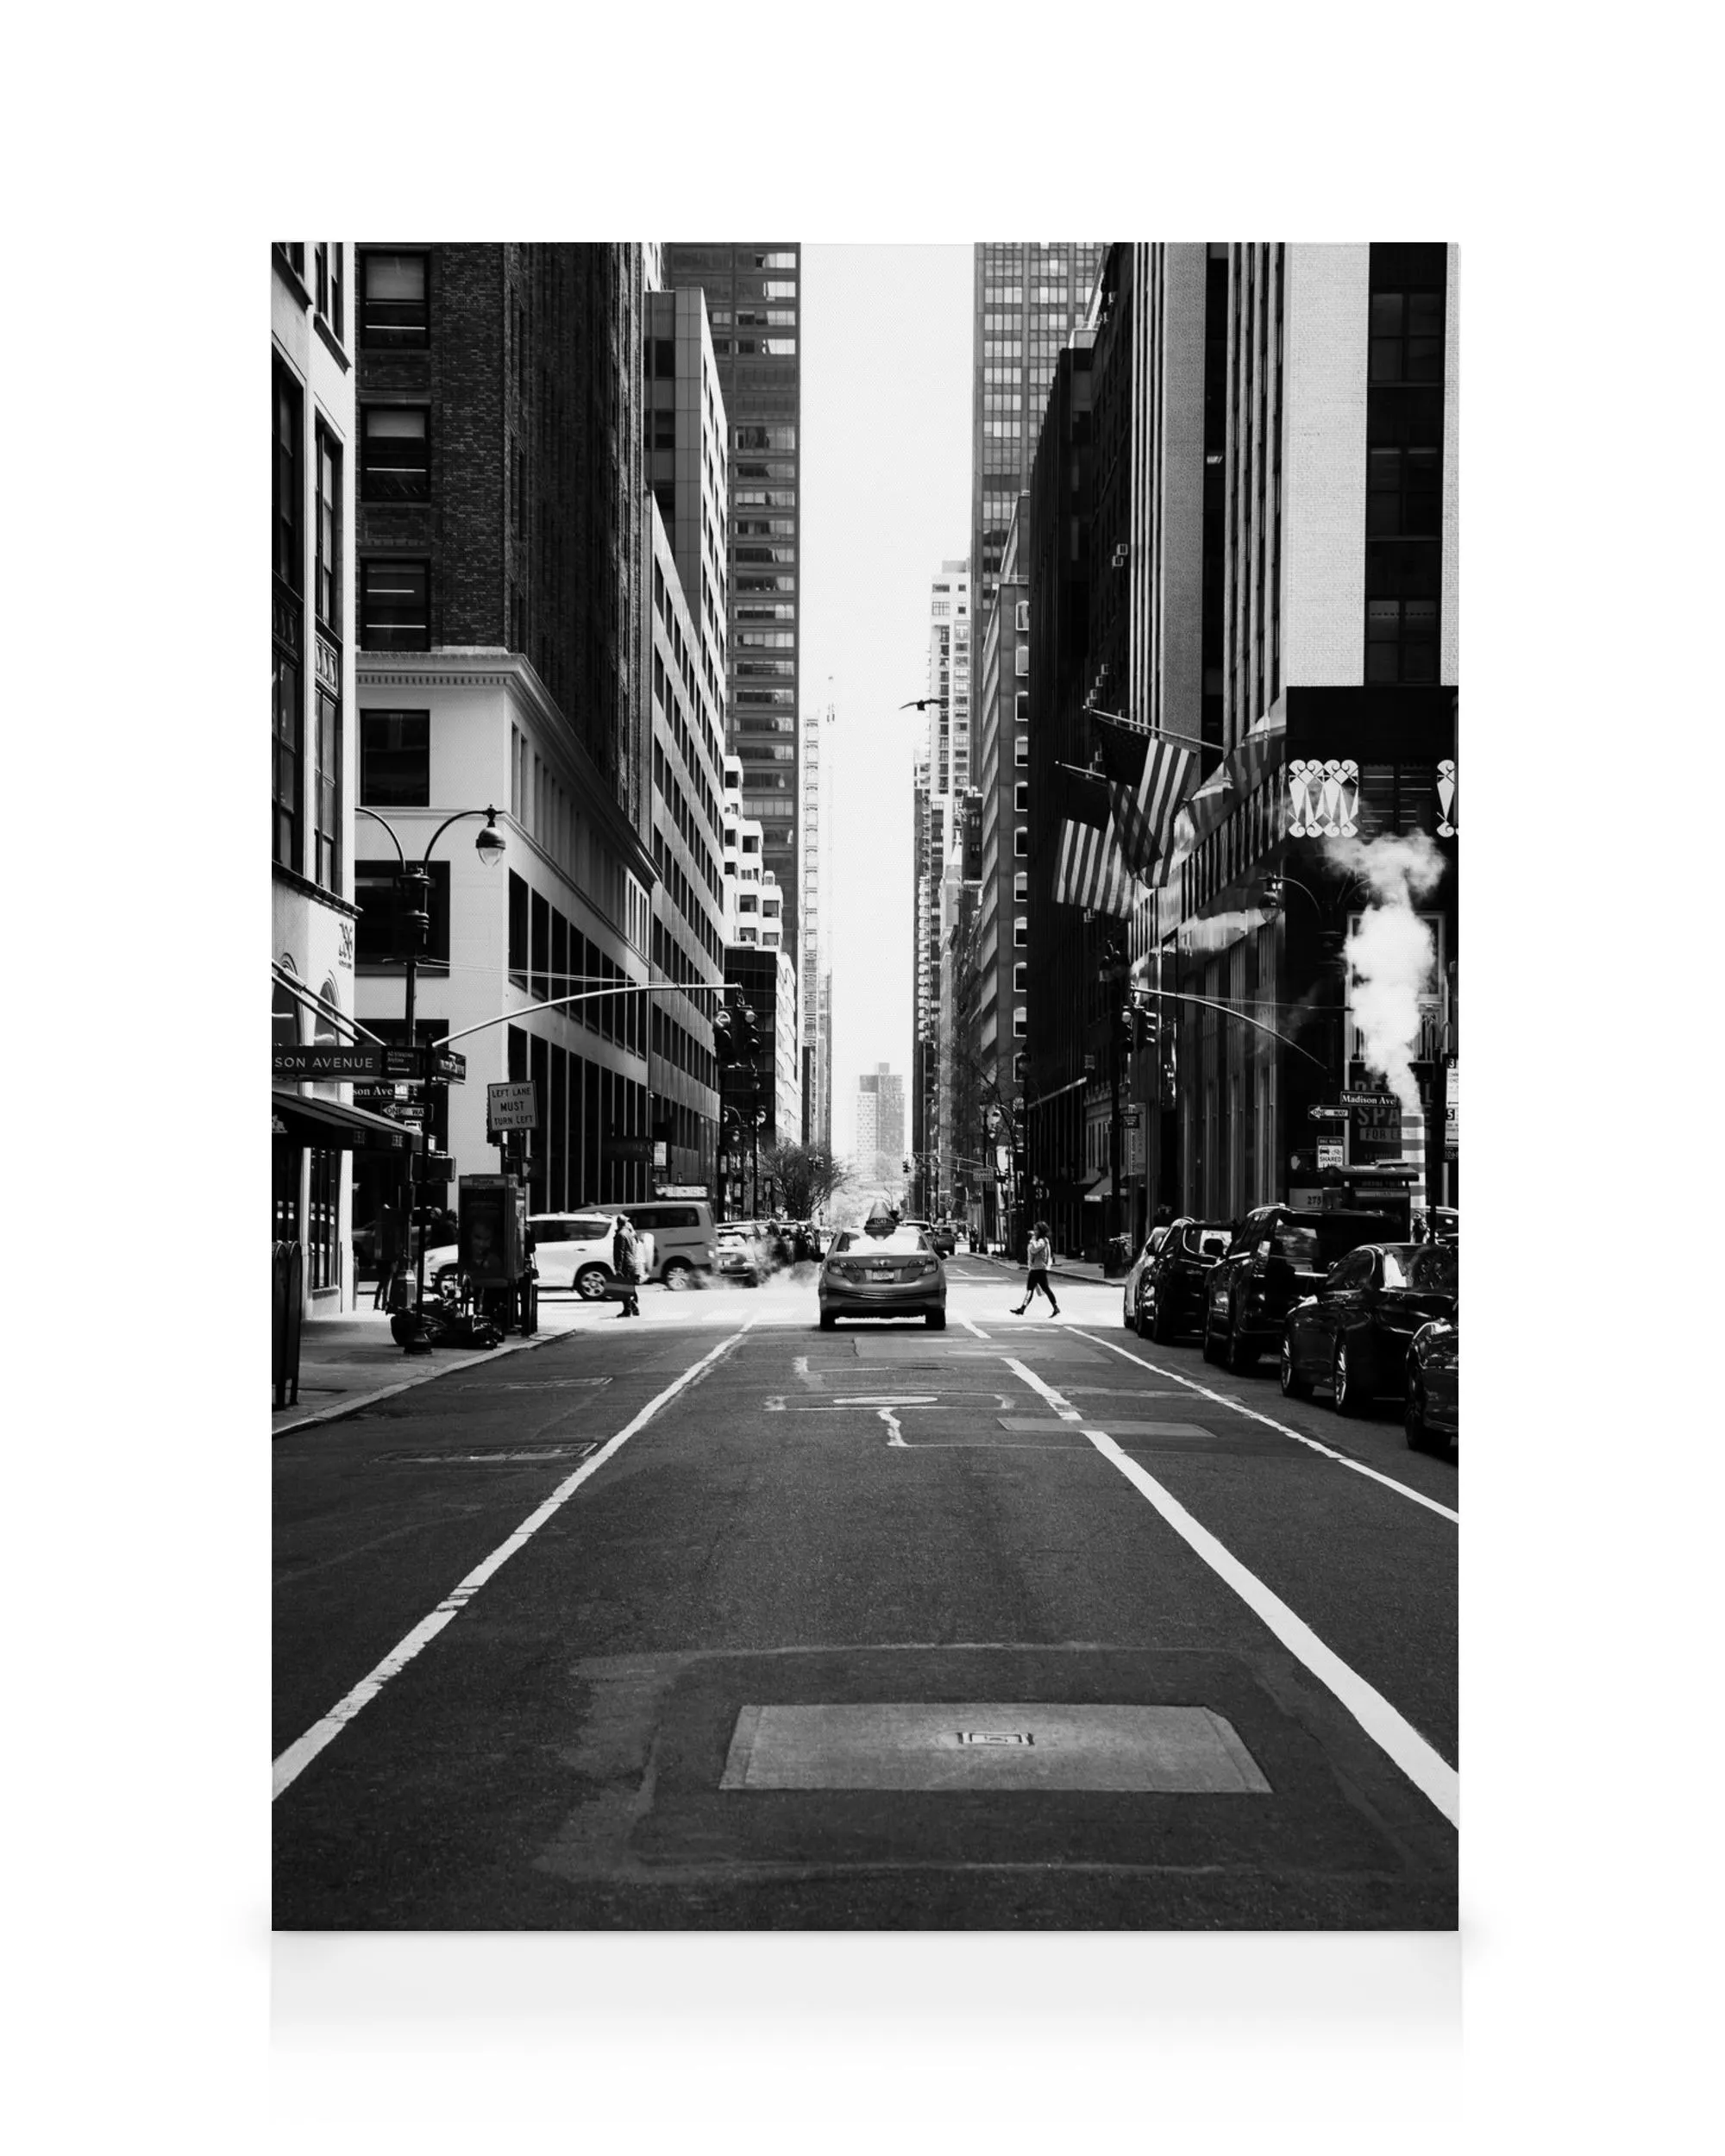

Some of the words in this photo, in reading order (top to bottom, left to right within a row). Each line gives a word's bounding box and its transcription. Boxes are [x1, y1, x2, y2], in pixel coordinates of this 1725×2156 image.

[312, 1056, 373, 1069] AVENUE
[373, 1086, 393, 1096] Ave
[492, 1088, 509, 1098] LEFT
[512, 1087, 532, 1096] LANE
[1342, 1094, 1377, 1105] Madison
[1379, 1096, 1396, 1105] Ave
[500, 1100, 524, 1112] MUST
[386, 1107, 404, 1116] ONE
[412, 1107, 425, 1116] WA
[494, 1116, 513, 1125] TURN
[517, 1115, 533, 1124] LEFT
[1365, 1129, 1386, 1139] FOR
